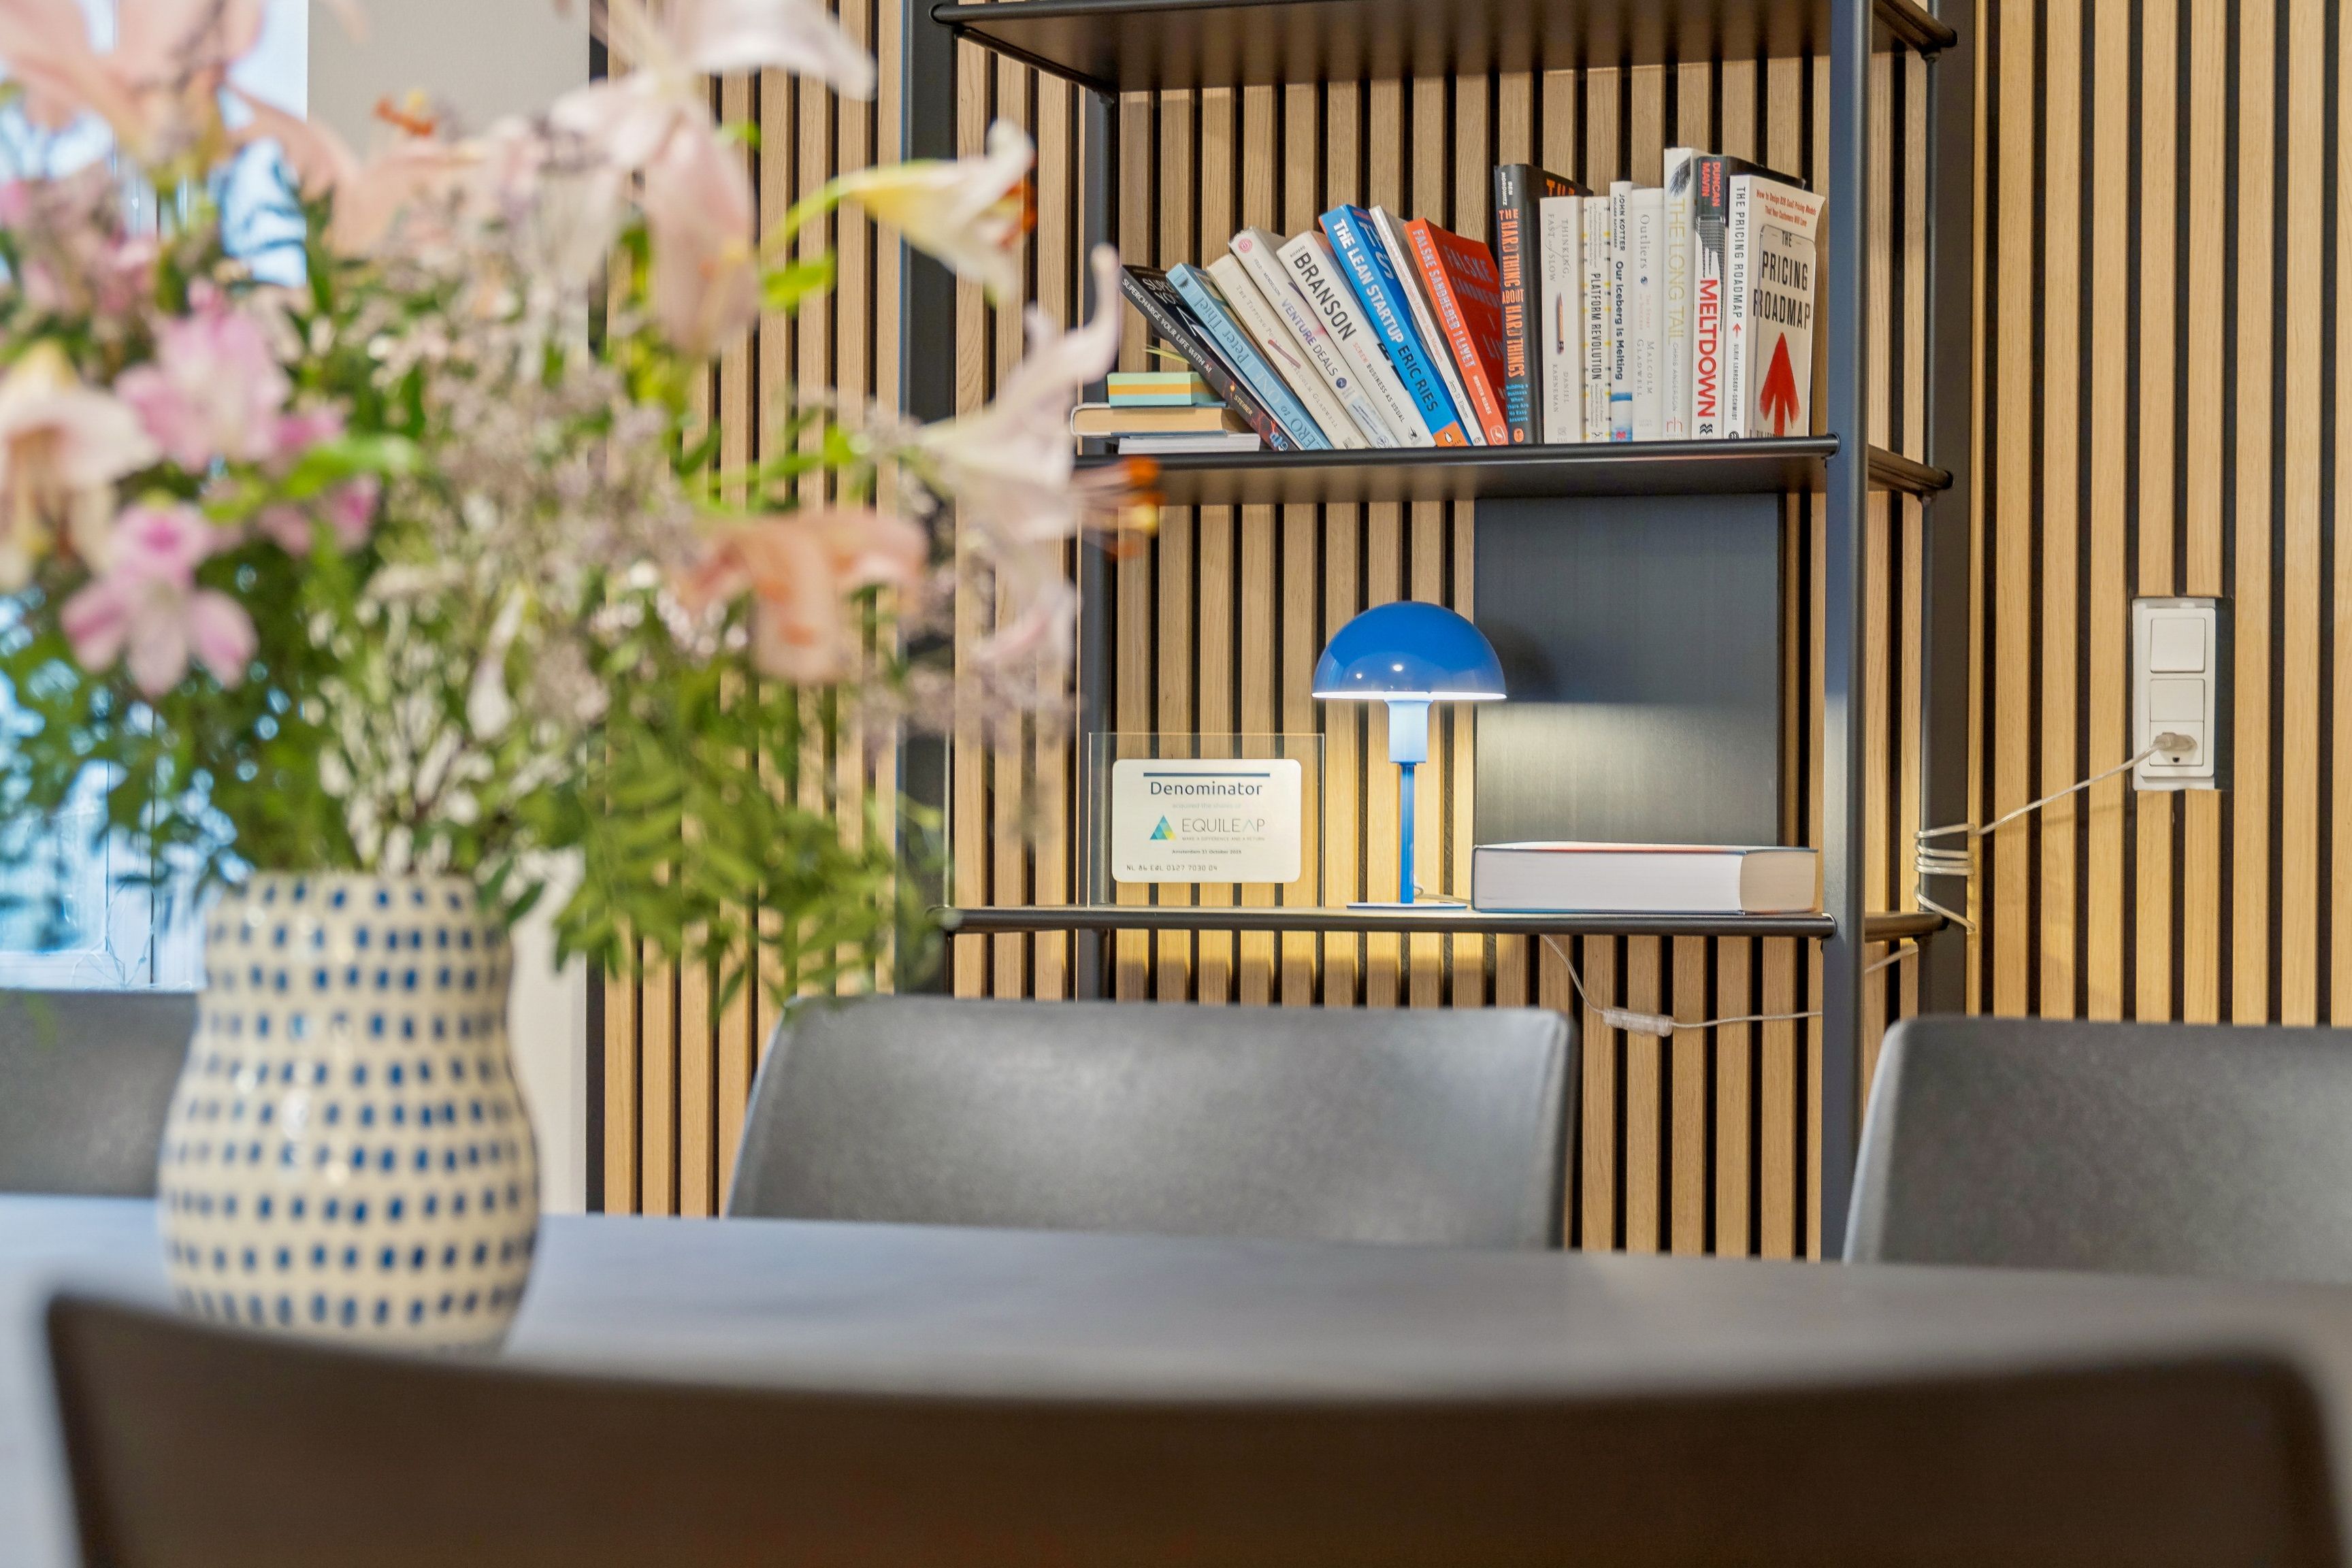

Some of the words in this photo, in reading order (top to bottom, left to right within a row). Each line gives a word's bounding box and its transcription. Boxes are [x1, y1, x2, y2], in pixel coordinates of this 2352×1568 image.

[1701, 162, 1710, 197] MAVIN
[1712, 161, 1720, 207] DUNCAN
[1735, 186, 1746, 207] THE
[1499, 208, 1520, 220] THE
[1668, 198, 1686, 238] THE
[1756, 190, 1765, 199] How
[1769, 193, 1779, 205] Design
[1795, 201, 1805, 214] Pricing
[1806, 205, 1816, 216] Models
[1779, 210, 1793, 223] Customers
[1501, 220, 1519, 252] HARD
[1639, 214, 1650, 270] Outliers
[1735, 212, 1745, 259] PRICING
[1782, 231, 1792, 247] THE
[1331, 217, 1356, 250] THE
[1346, 246, 1374, 285] LEAN
[1365, 282, 1405, 346] STARTUP
[1503, 253, 1521, 287] THING
[1615, 261, 1624, 280] Our
[1667, 244, 1686, 300] LONG
[1762, 250, 1808, 291] PRICING
[1292, 252, 1358, 342] BRANSON
[1411, 227, 1438, 270] FALSKE
[1454, 336, 1476, 369] LIVET
[1501, 288, 1524, 304] ABOUT
[1590, 273, 1601, 320] PLATFORM
[1614, 284, 1624, 325] Iceberg
[1733, 264, 1744, 318] ROADMAP
[1753, 289, 1810, 330] ROADMAP
[1120, 277, 1162, 322] SUPERCHARGE
[1159, 318, 1177, 337] YOUR
[1174, 333, 1190, 350] LIFE
[1186, 346, 1205, 366] WITH
[1202, 362, 1212, 373] AI
[1192, 295, 1224, 331] Thiel
[1505, 305, 1523, 337] HARD
[1616, 328, 1624, 337] Is
[1667, 305, 1684, 345] TAIL
[1220, 328, 1250, 364] Peter
[1279, 298, 1318, 346] VENTURE
[1310, 343, 1339, 377] DEALS
[1590, 324, 1602, 379] REVOLUTION
[1697, 279, 1718, 417] MELTDOWN
[1507, 338, 1525, 378] THINGS
[1614, 340, 1624, 380] Melting
[1251, 370, 1284, 406] ONE
[1352, 342, 1369, 364] SCREW
[1365, 363, 1388, 393] BUSINESS
[1385, 393, 1393, 402] AS
[1390, 402, 1406, 423] USUAL
[1396, 344, 1422, 379] ERIC
[1414, 378, 1439, 413] RIES
[1278, 404, 1291, 417] to
[1150, 781, 1263, 796] Denominator
